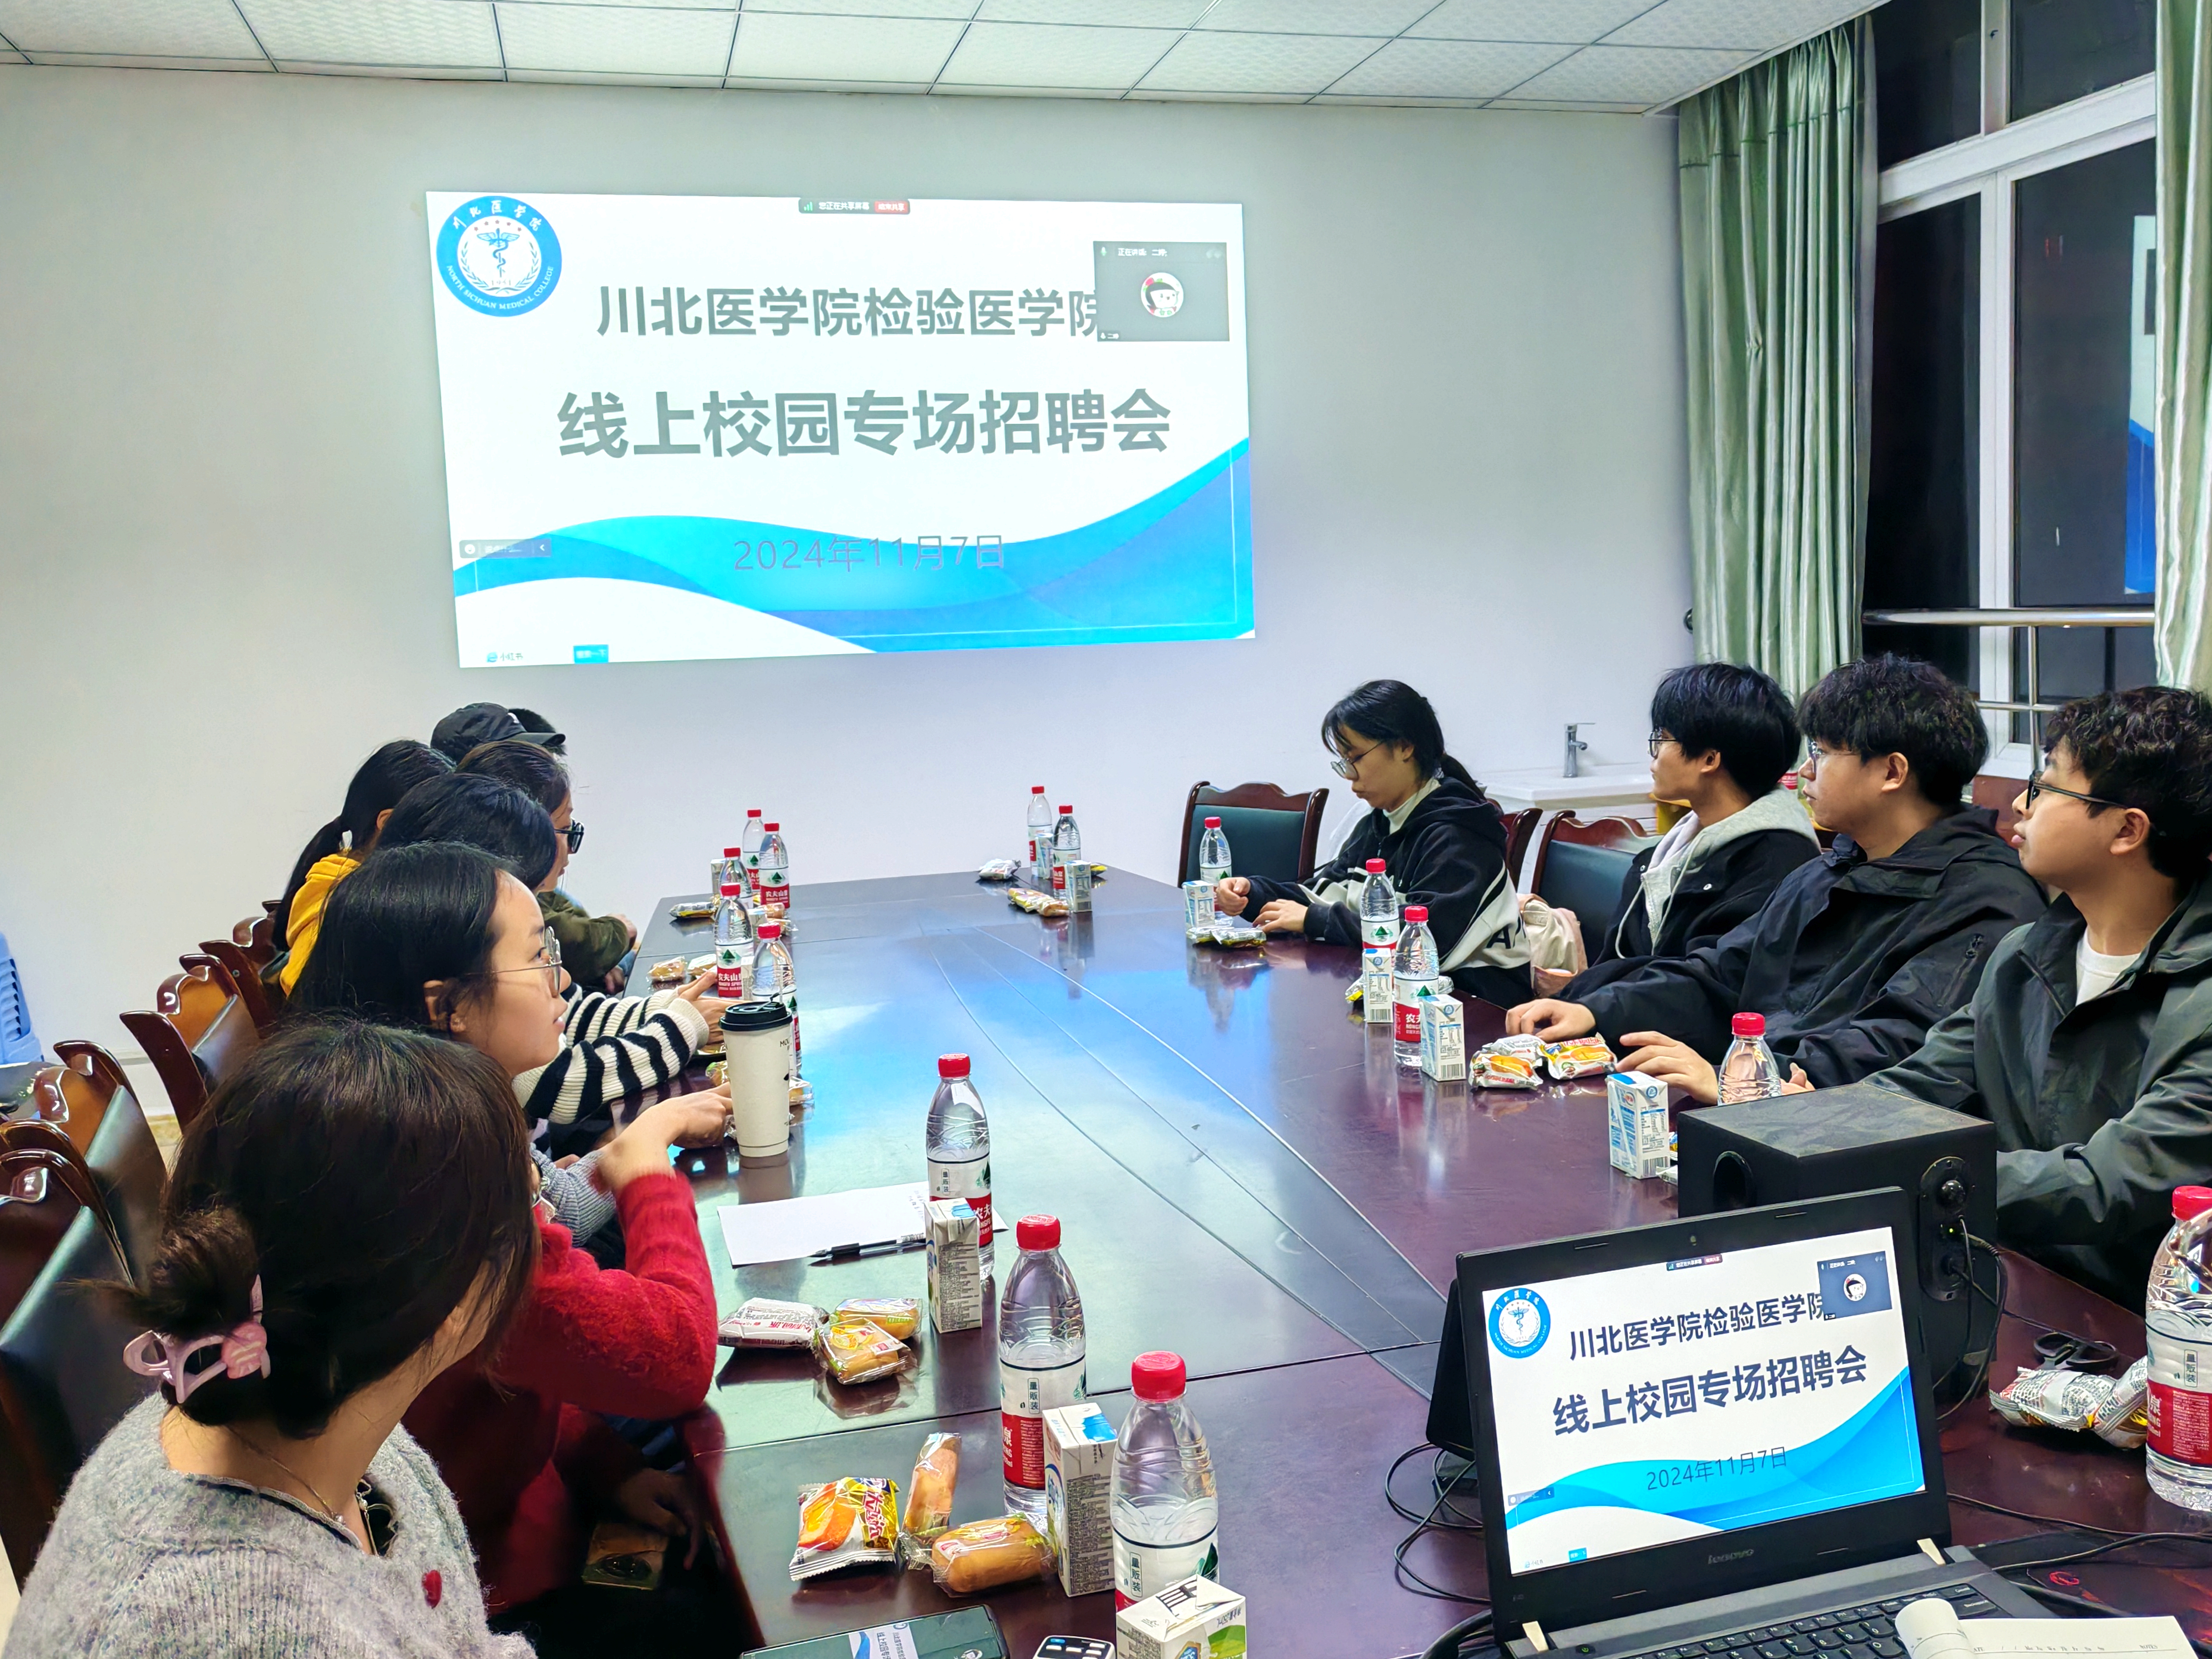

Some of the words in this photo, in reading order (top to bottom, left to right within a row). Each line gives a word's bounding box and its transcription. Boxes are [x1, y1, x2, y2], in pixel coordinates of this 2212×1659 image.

[446, 265, 465, 290] NORTH
[463, 289, 497, 309] SICHUAN
[499, 296, 534, 310] MEDICAL
[533, 265, 554, 296] COLLEGE
[557, 388, 1171, 458] 线上校园专场招聘会
[734, 535, 1005, 573] 2024年11月7日
[1029, 1382, 1039, 1410] 量贩装
[1552, 1345, 1867, 1437] 线上校园专场招聘会
[1646, 1446, 1787, 1492] 2024年11月7日
[1132, 1557, 1141, 1593] 量贩装
